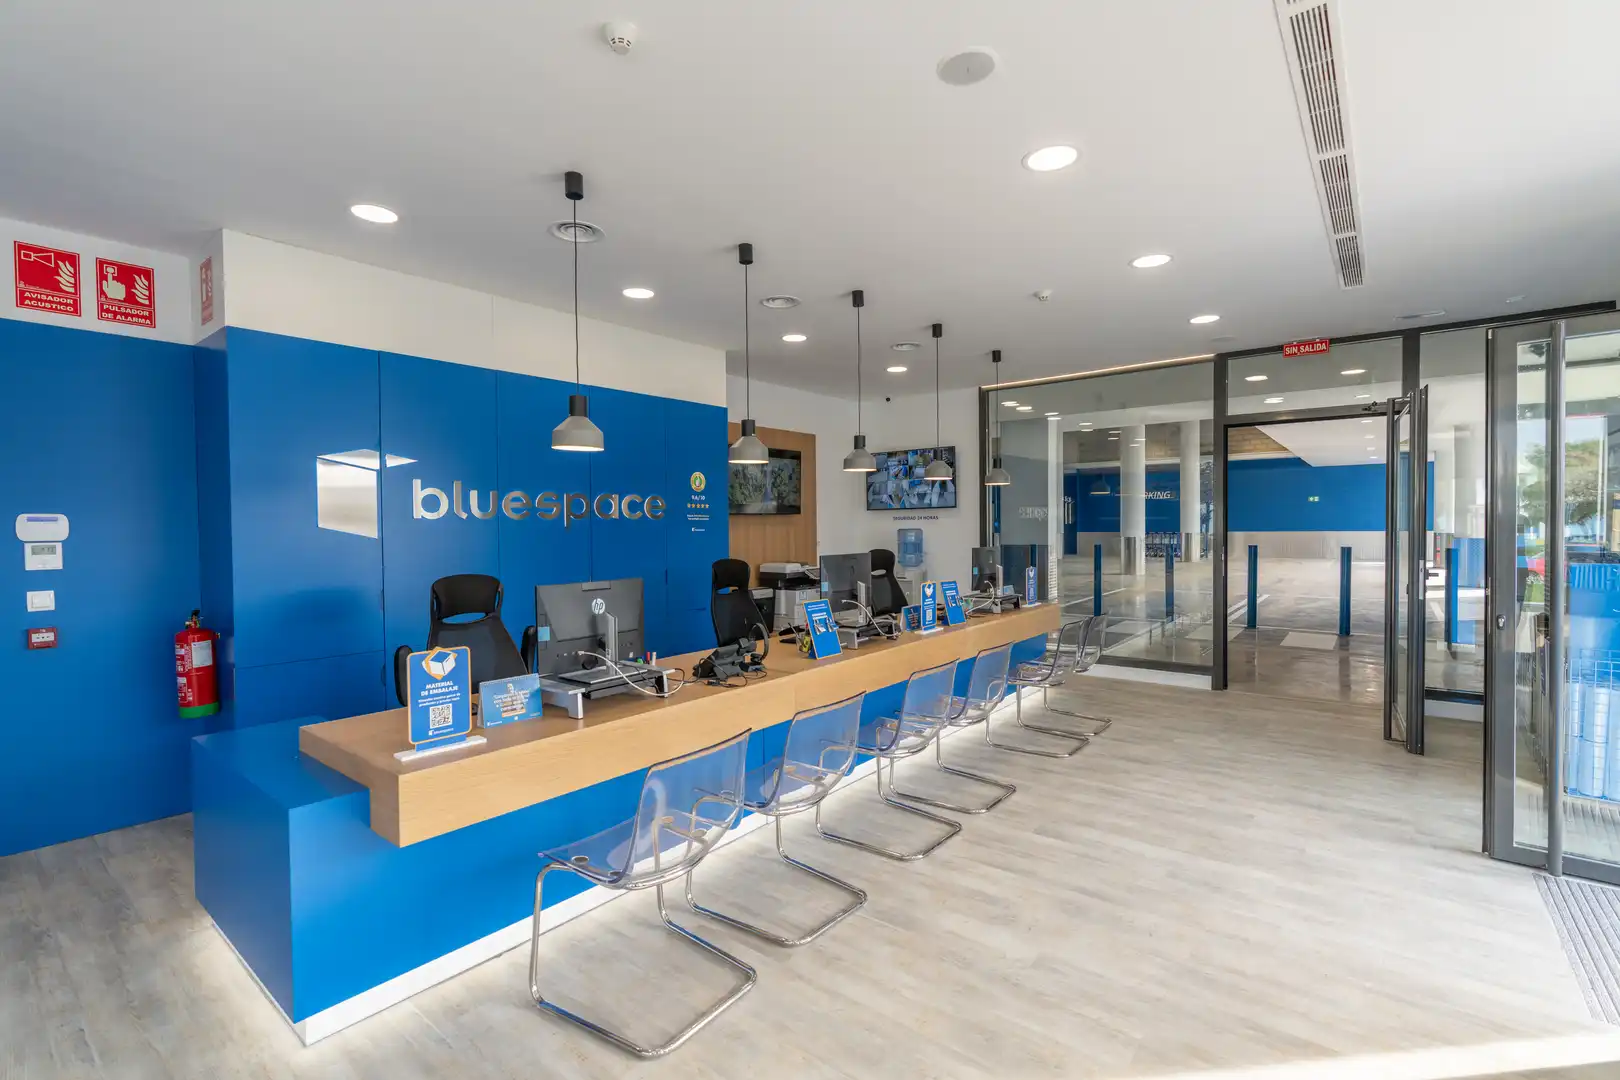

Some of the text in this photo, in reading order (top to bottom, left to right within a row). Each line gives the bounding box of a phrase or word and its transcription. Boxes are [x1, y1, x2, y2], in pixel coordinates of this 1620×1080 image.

[24, 292, 74, 304] AVISADOR
[24, 300, 74, 312] ACUSTICO
[103, 305, 150, 317] PULSADOR
[116, 315, 151, 325] ALARMA
[1285, 343, 1326, 355] SIN SALIDA
[1144, 491, 1171, 500] RKING
[412, 478, 667, 528] bluespace
[593, 598, 605, 614] hp
[426, 680, 454, 690] MATERIAL
[430, 685, 459, 695] EMBALAJE
